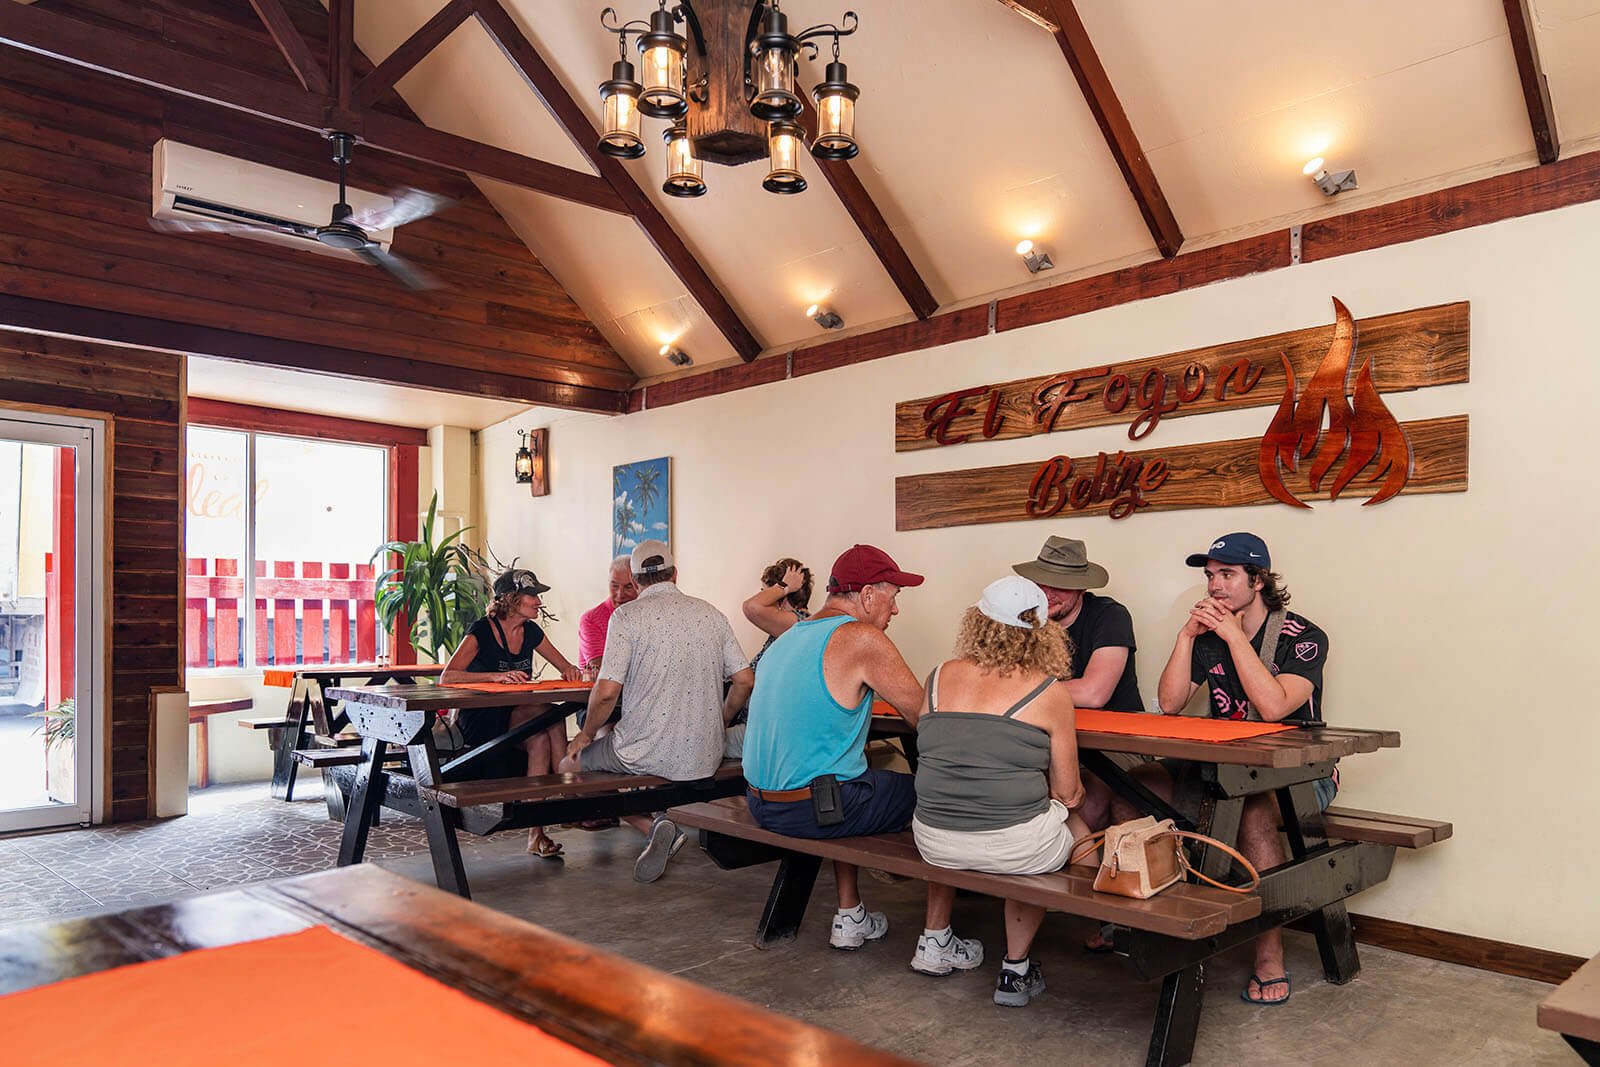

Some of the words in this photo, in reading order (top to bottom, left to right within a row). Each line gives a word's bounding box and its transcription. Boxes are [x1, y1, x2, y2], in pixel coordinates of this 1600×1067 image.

[924, 386, 1005, 445] El
[1033, 358, 1265, 441] Fogon
[1025, 450, 1170, 520] Belize
